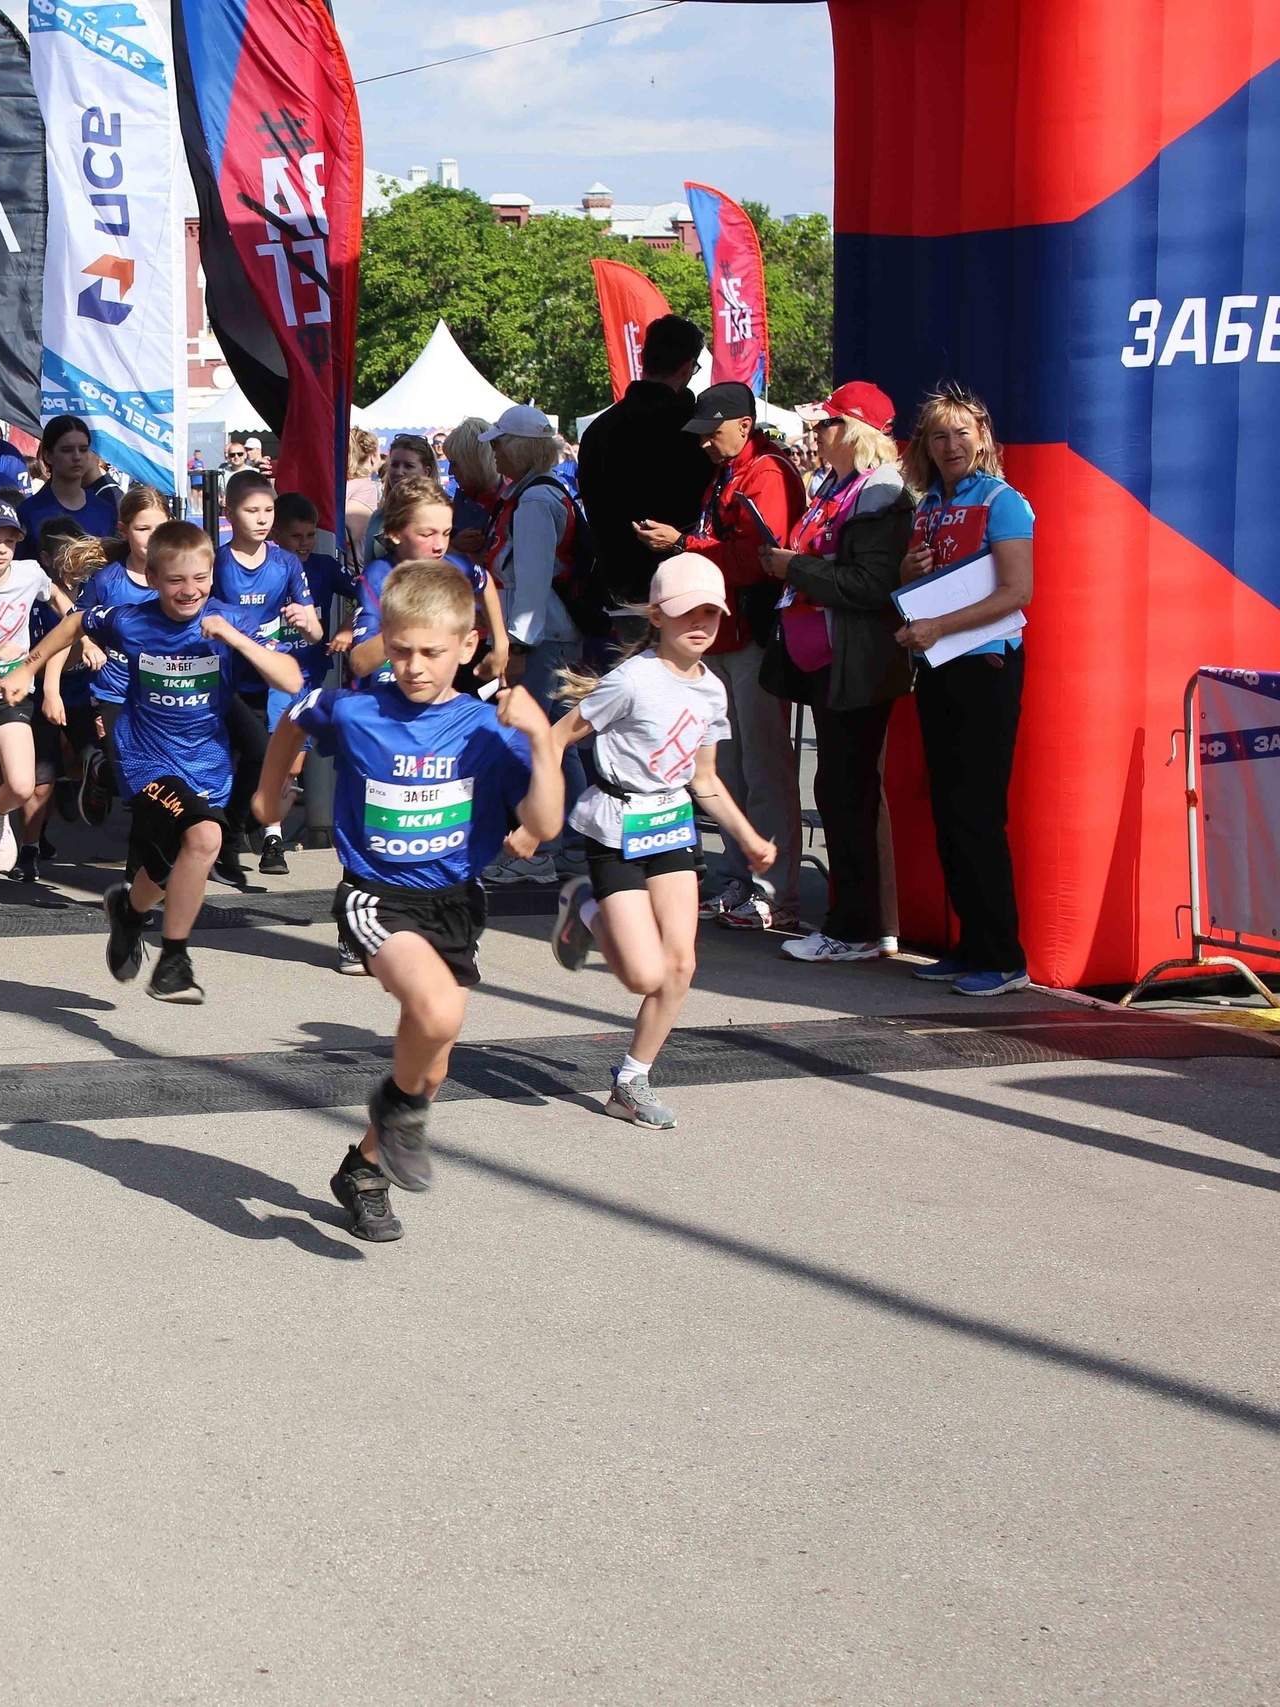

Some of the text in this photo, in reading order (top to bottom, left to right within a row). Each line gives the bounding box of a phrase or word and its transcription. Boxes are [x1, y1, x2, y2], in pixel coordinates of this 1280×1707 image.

[149, 692, 210, 707] 20147
[369, 830, 466, 856] 20090
[627, 826, 692, 853] 20083
